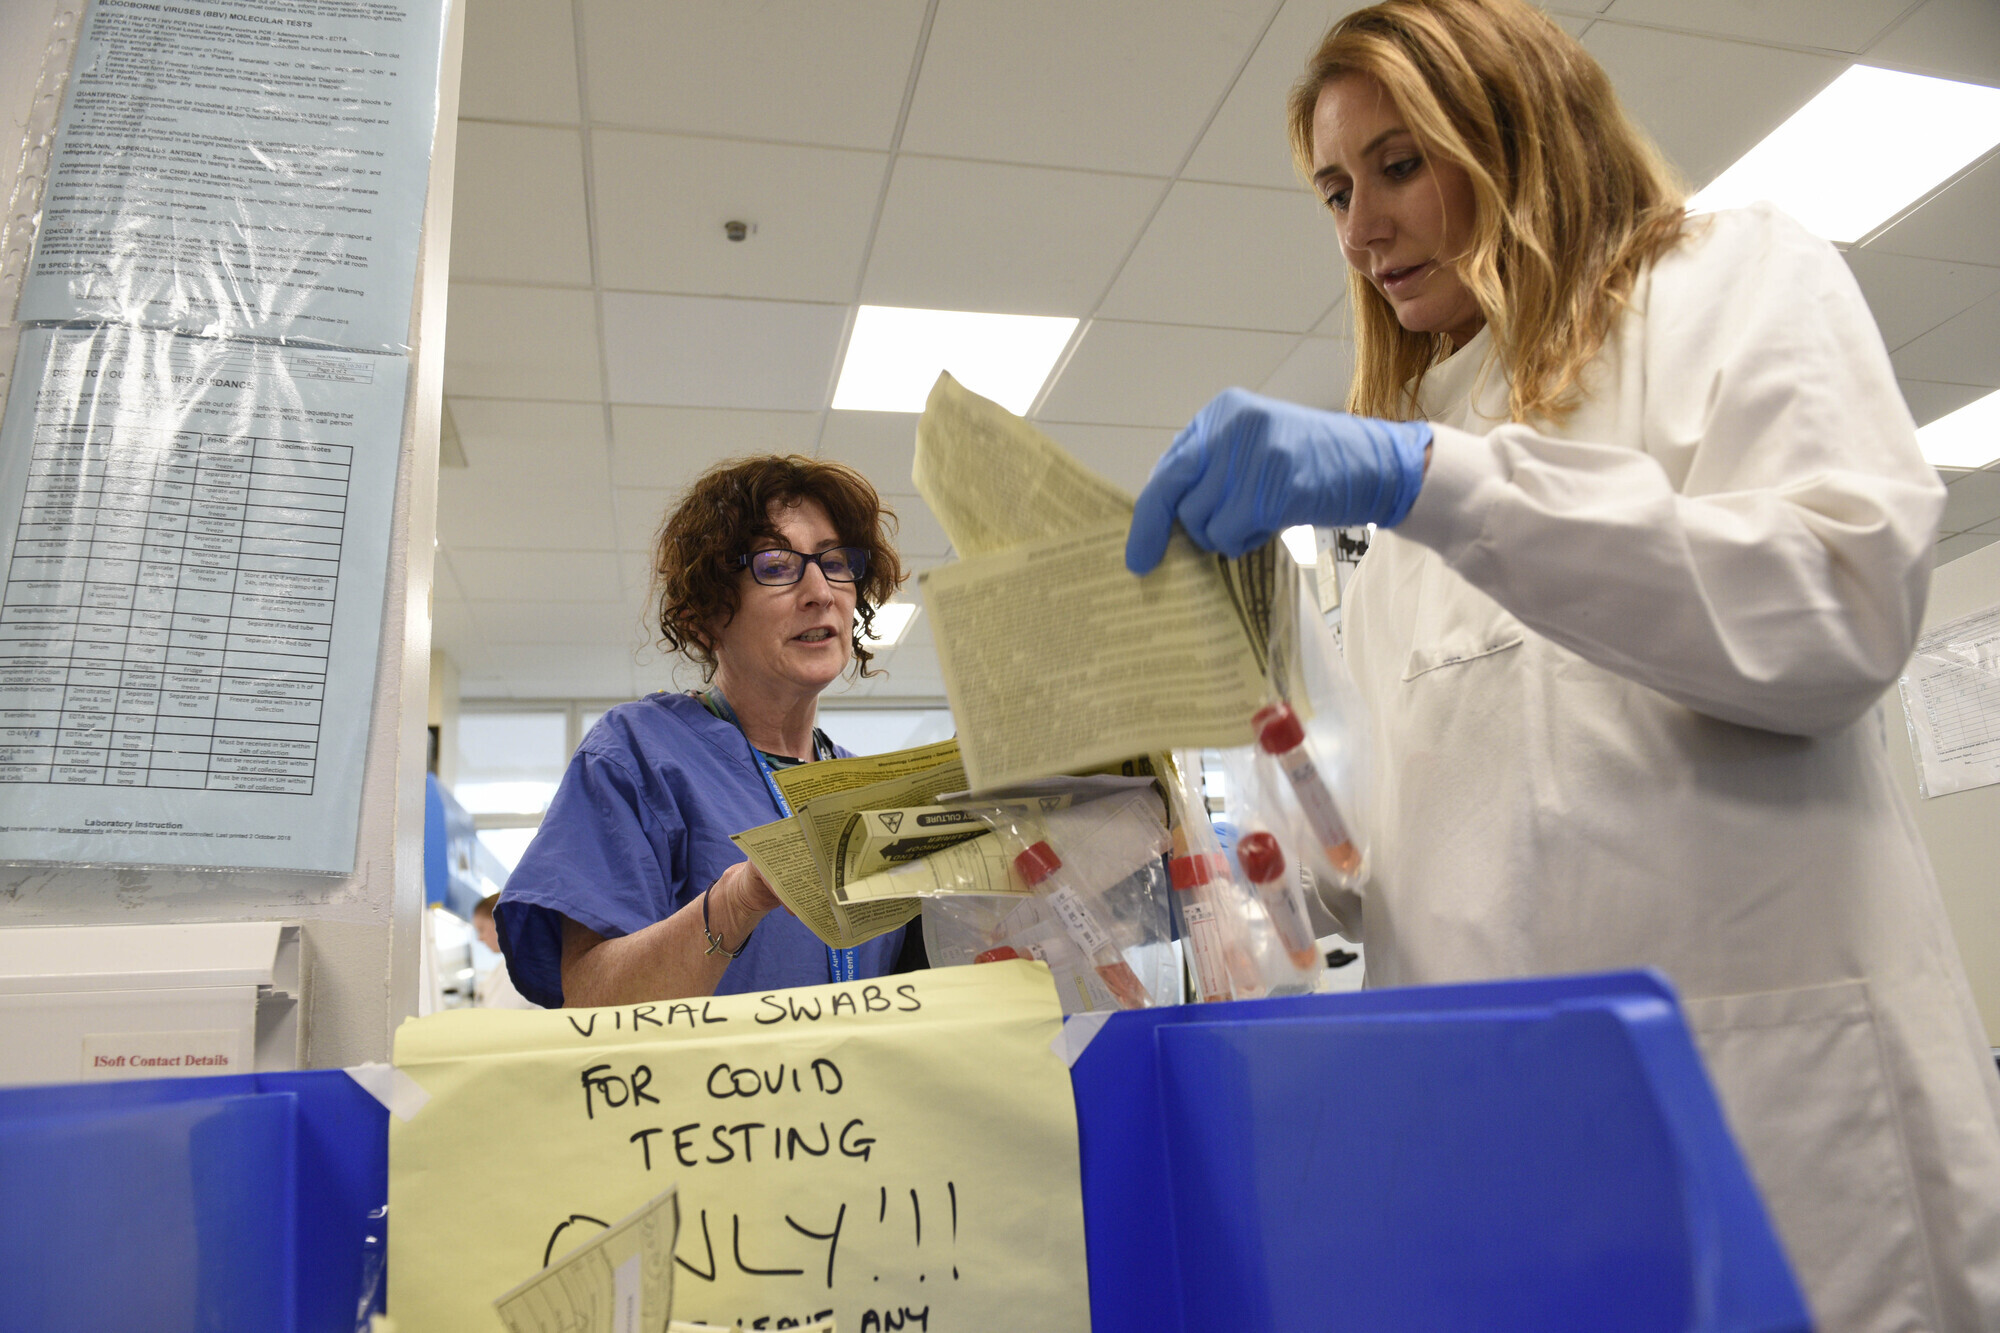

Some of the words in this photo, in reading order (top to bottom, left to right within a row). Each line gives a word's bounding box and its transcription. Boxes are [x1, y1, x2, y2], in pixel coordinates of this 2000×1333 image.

[164, 6, 200, 16] VIRUSES
[230, 14, 283, 25] MOLECULAR
[286, 19, 312, 28] TESTS
[766, 770, 784, 799] Vincent's
[84, 818, 133, 829] Laboratory
[135, 820, 183, 830] Instruction
[925, 814, 961, 824] CULTURE
[906, 842, 951, 852] AKPROOF
[568, 1001, 728, 1038] VIRAL
[753, 983, 923, 1027] SWABS
[94, 1054, 126, 1067] ISoft
[129, 1054, 182, 1067] Contact
[185, 1052, 229, 1067] Details
[581, 1063, 660, 1119] FOR
[706, 1058, 843, 1100] COVID
[630, 1119, 876, 1170] TESTING
[861, 1305, 930, 1333] ANY
